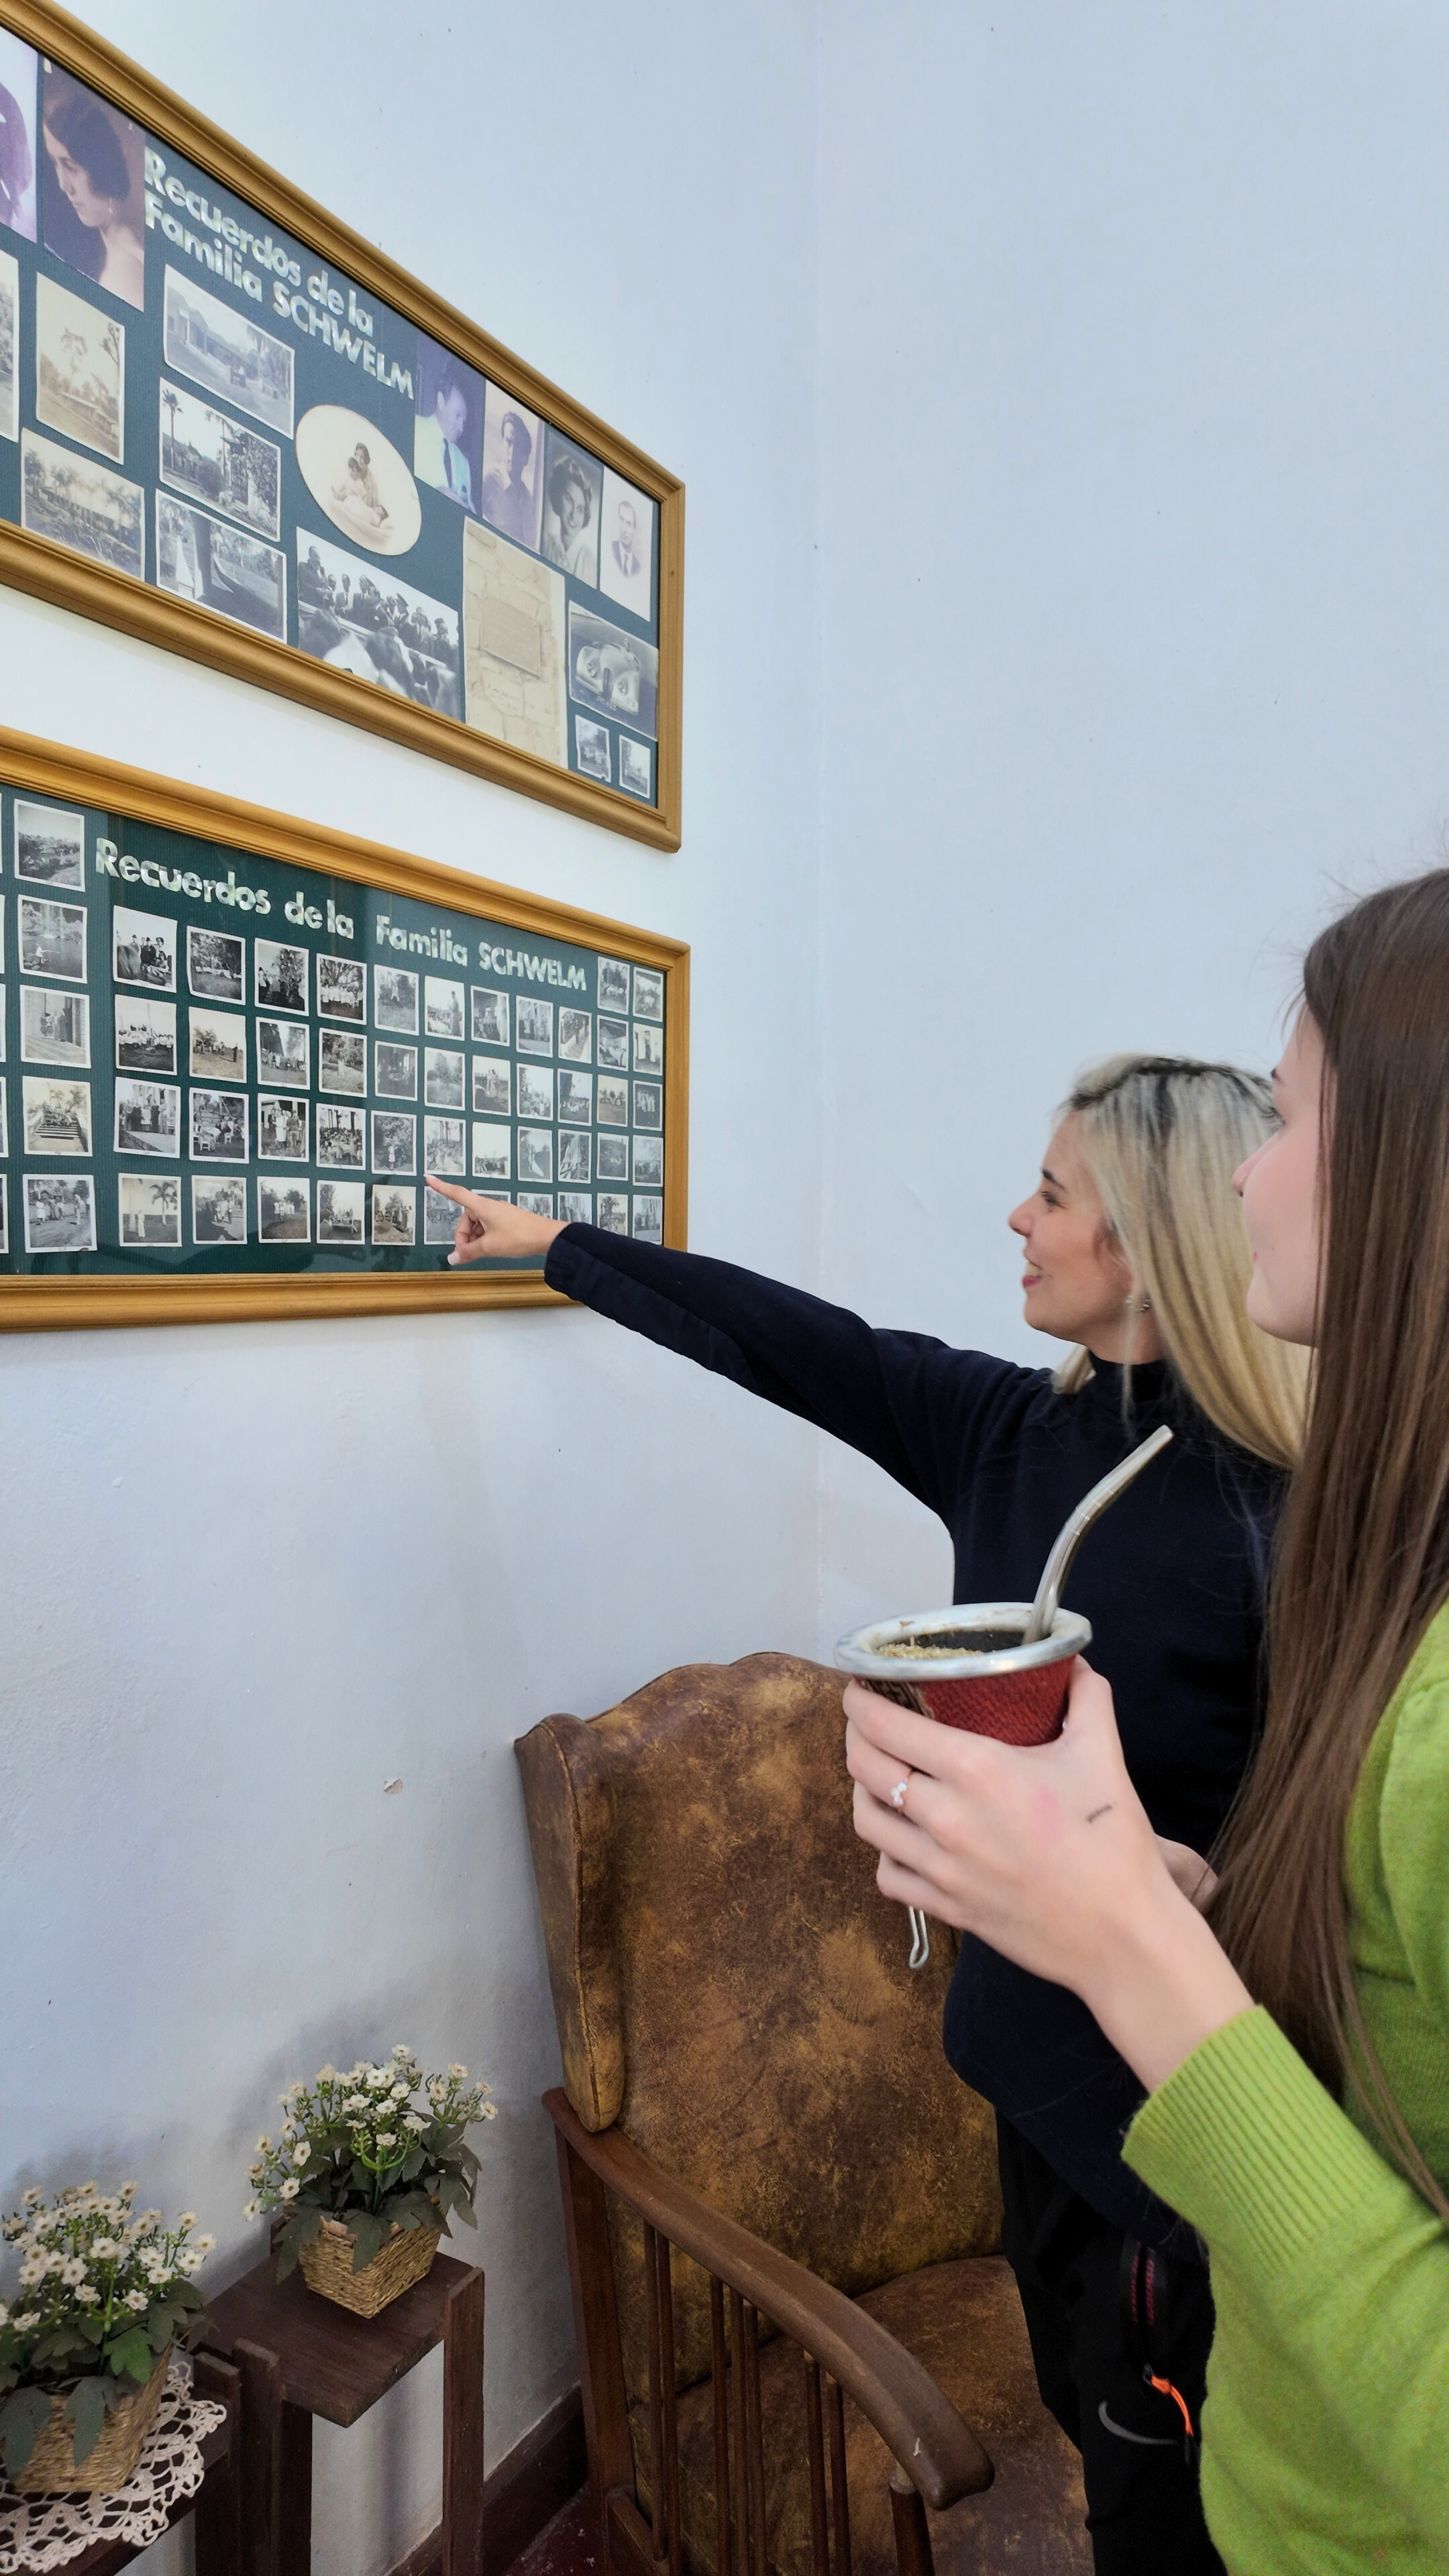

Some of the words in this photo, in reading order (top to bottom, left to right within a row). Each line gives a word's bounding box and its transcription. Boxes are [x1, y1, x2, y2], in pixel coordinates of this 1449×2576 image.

[144, 146, 301, 287] Recuerdos
[307, 270, 345, 316] de
[348, 289, 374, 337] la
[144, 189, 263, 303] Familia
[272, 280, 415, 400] SCHWELM
[95, 837, 272, 914] Recuerdos
[283, 891, 323, 930] de
[325, 899, 354, 939] la
[375, 914, 468, 967] Familia
[478, 942, 587, 991] SCHWELM
